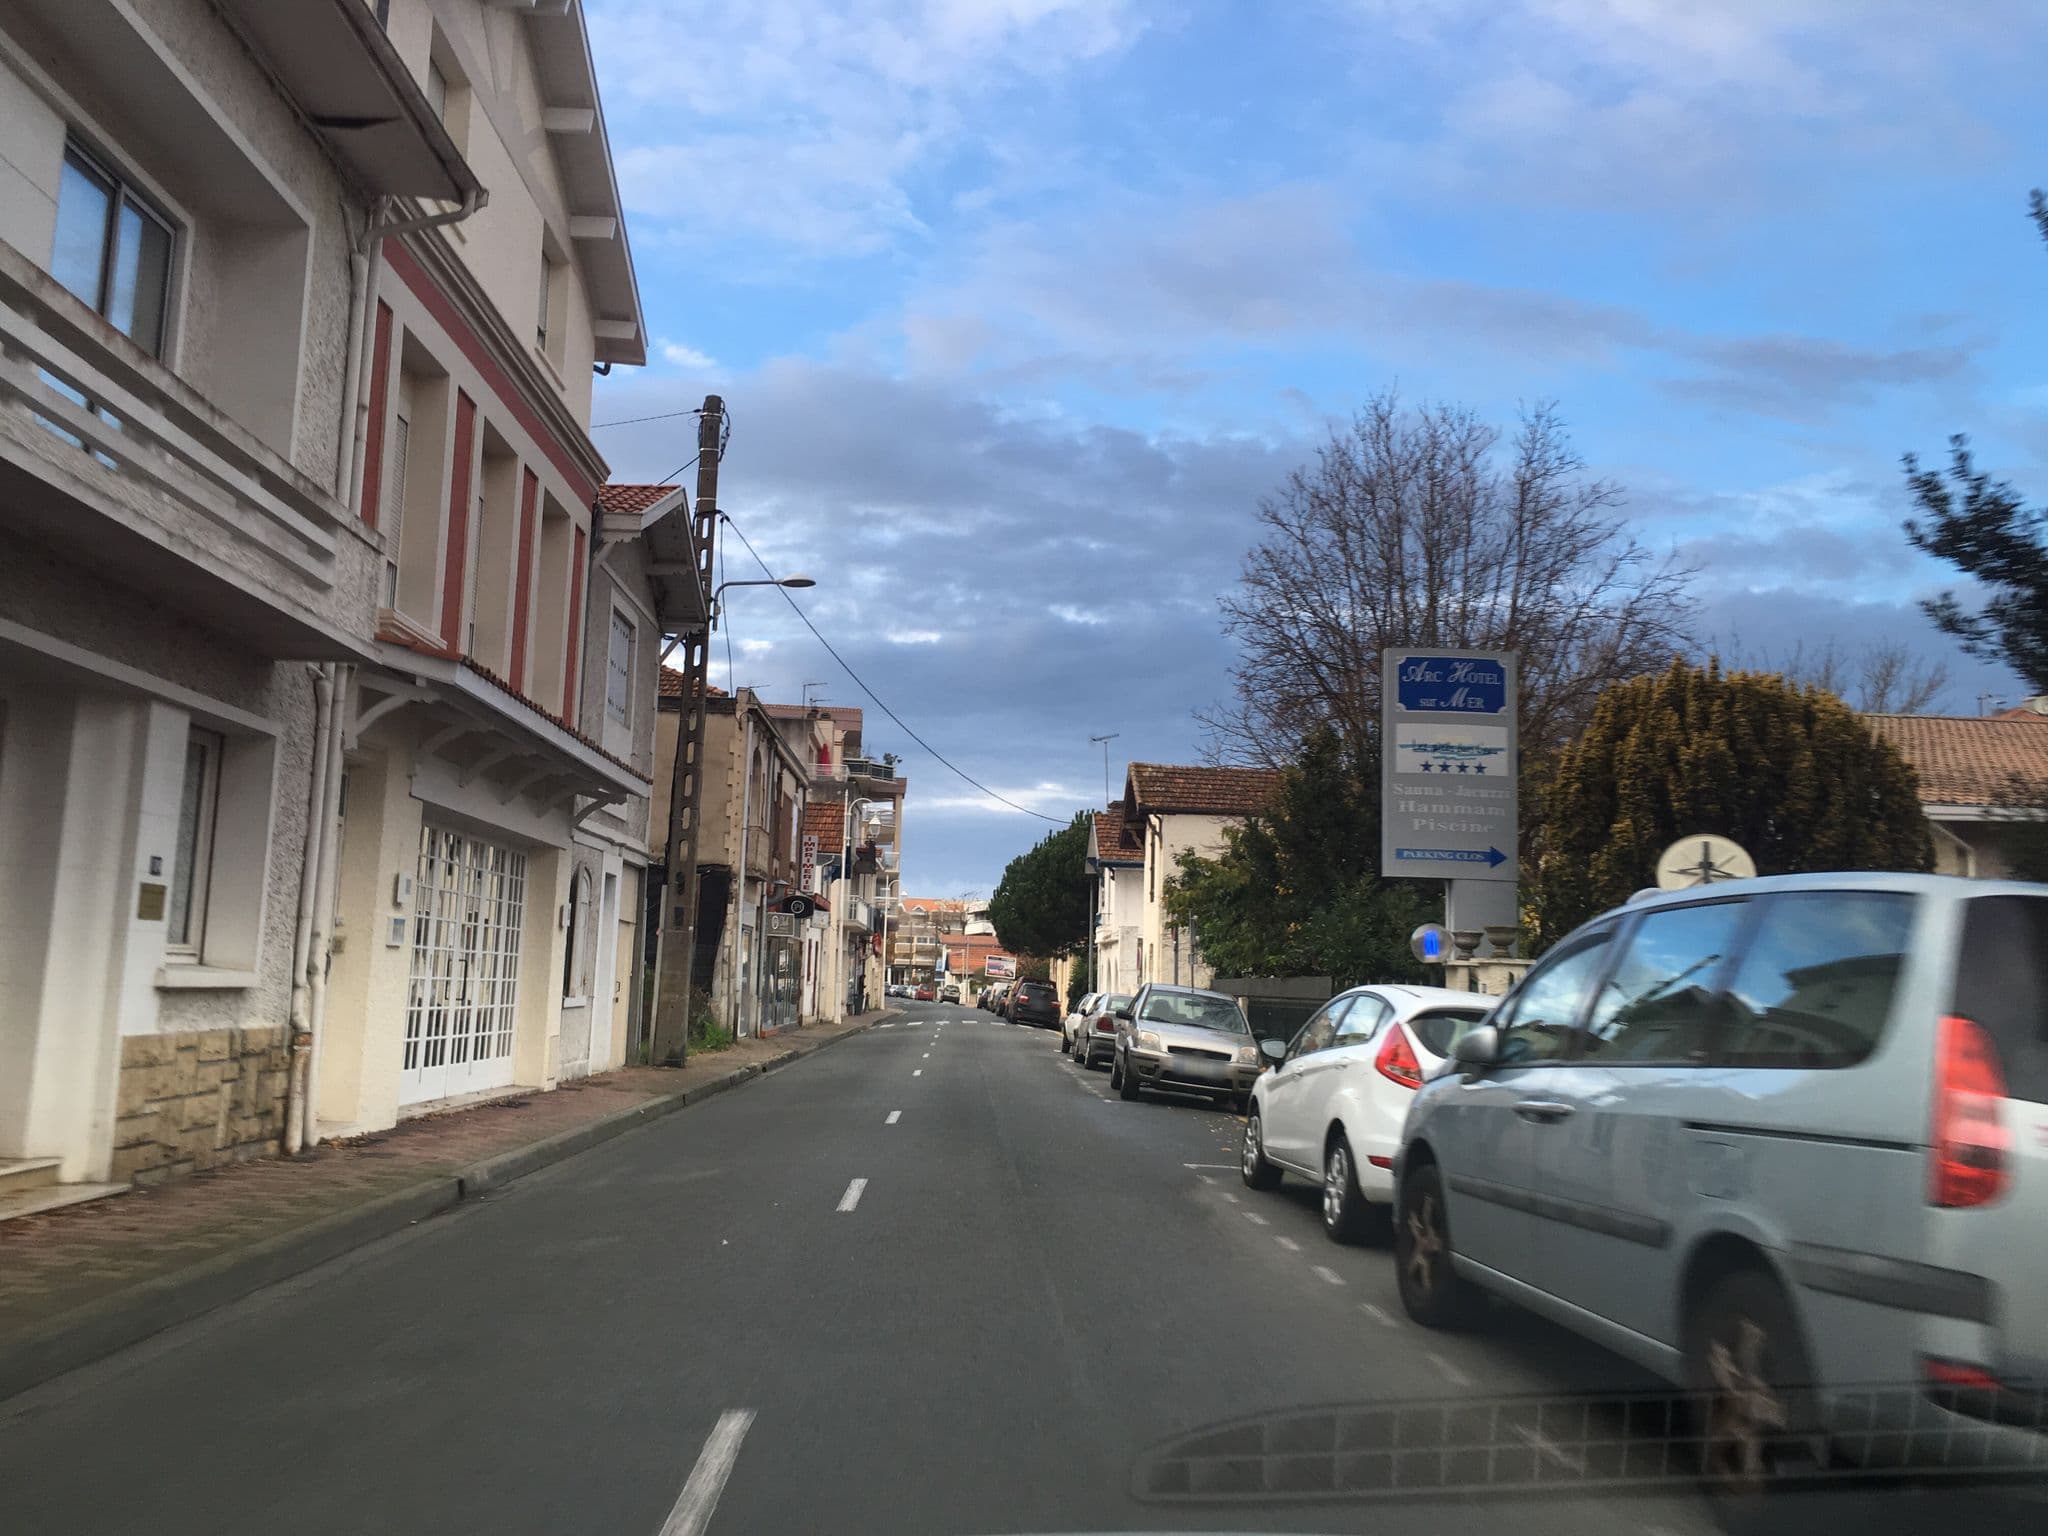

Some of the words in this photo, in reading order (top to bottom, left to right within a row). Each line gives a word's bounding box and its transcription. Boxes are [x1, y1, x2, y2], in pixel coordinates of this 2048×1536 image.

[1392, 783, 1442, 796] Sauna
[1398, 800, 1506, 816] Hammam
[1412, 818, 1496, 832] Piscine
[1402, 850, 1454, 860] PARKING
[803, 836, 816, 890] IMPRIMERIE
